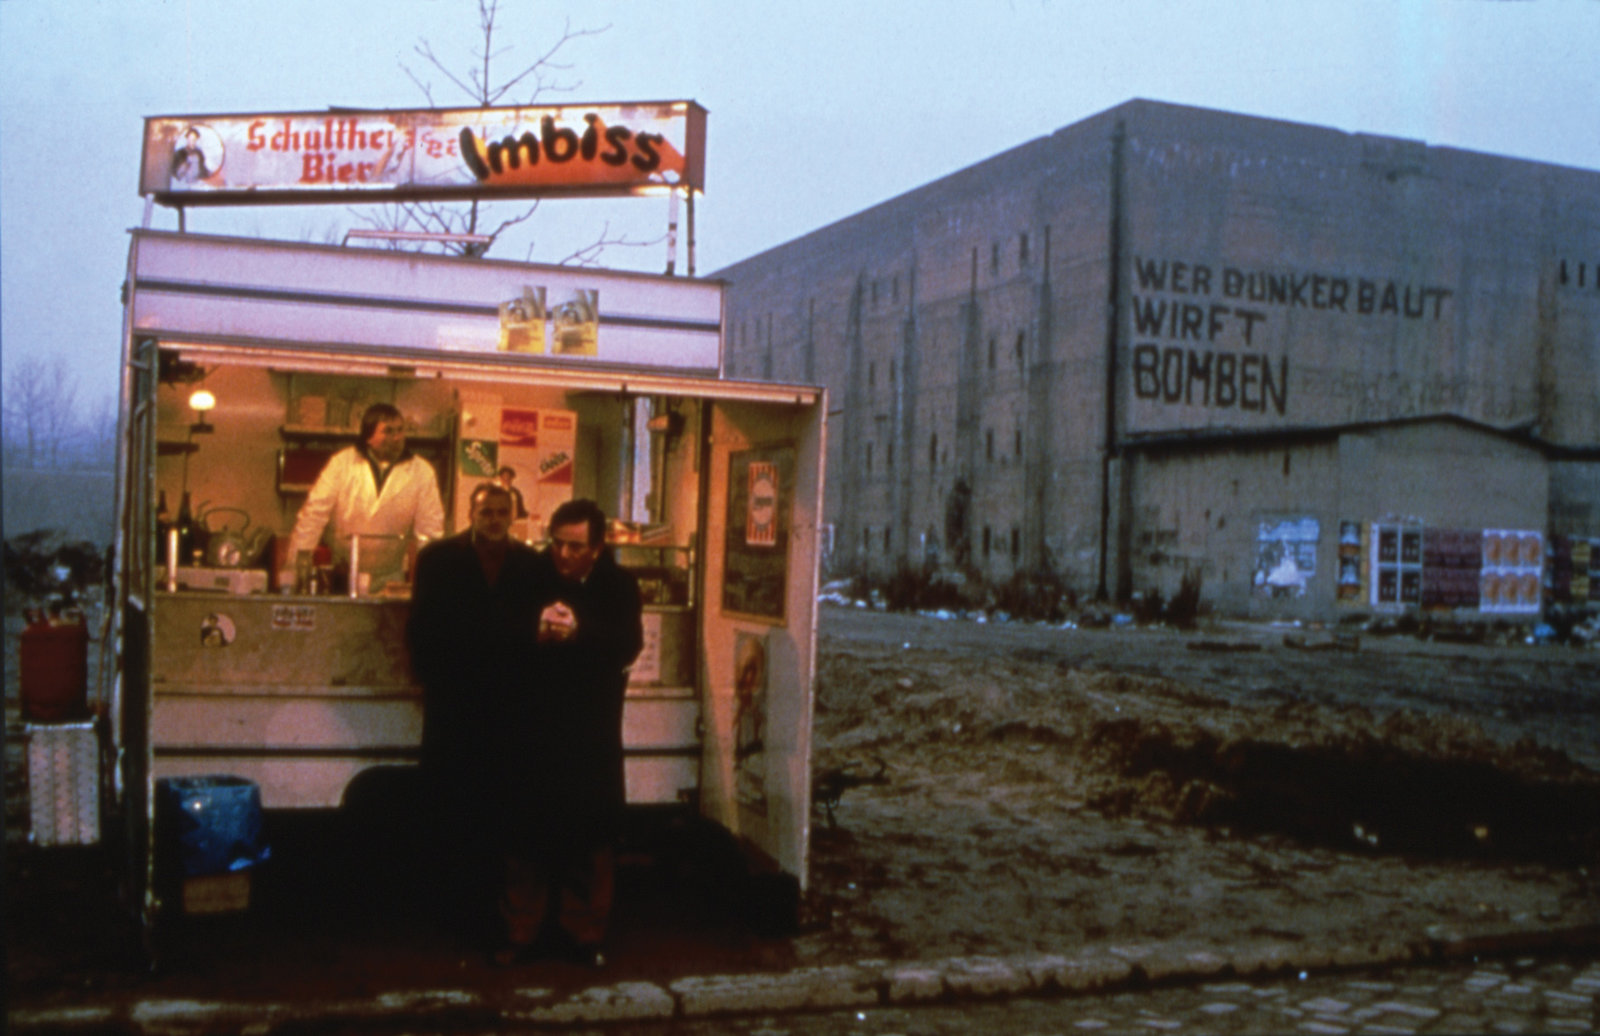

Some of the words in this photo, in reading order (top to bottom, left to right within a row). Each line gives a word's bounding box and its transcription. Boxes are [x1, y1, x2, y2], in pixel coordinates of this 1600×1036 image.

[300, 152, 372, 184] Bier
[458, 112, 665, 180] Imbiss
[1134, 256, 1212, 295] WER
[1357, 281, 1453, 320] BAUT
[1133, 296, 1267, 346] WIRFT
[1133, 344, 1288, 416] BOMBEN
